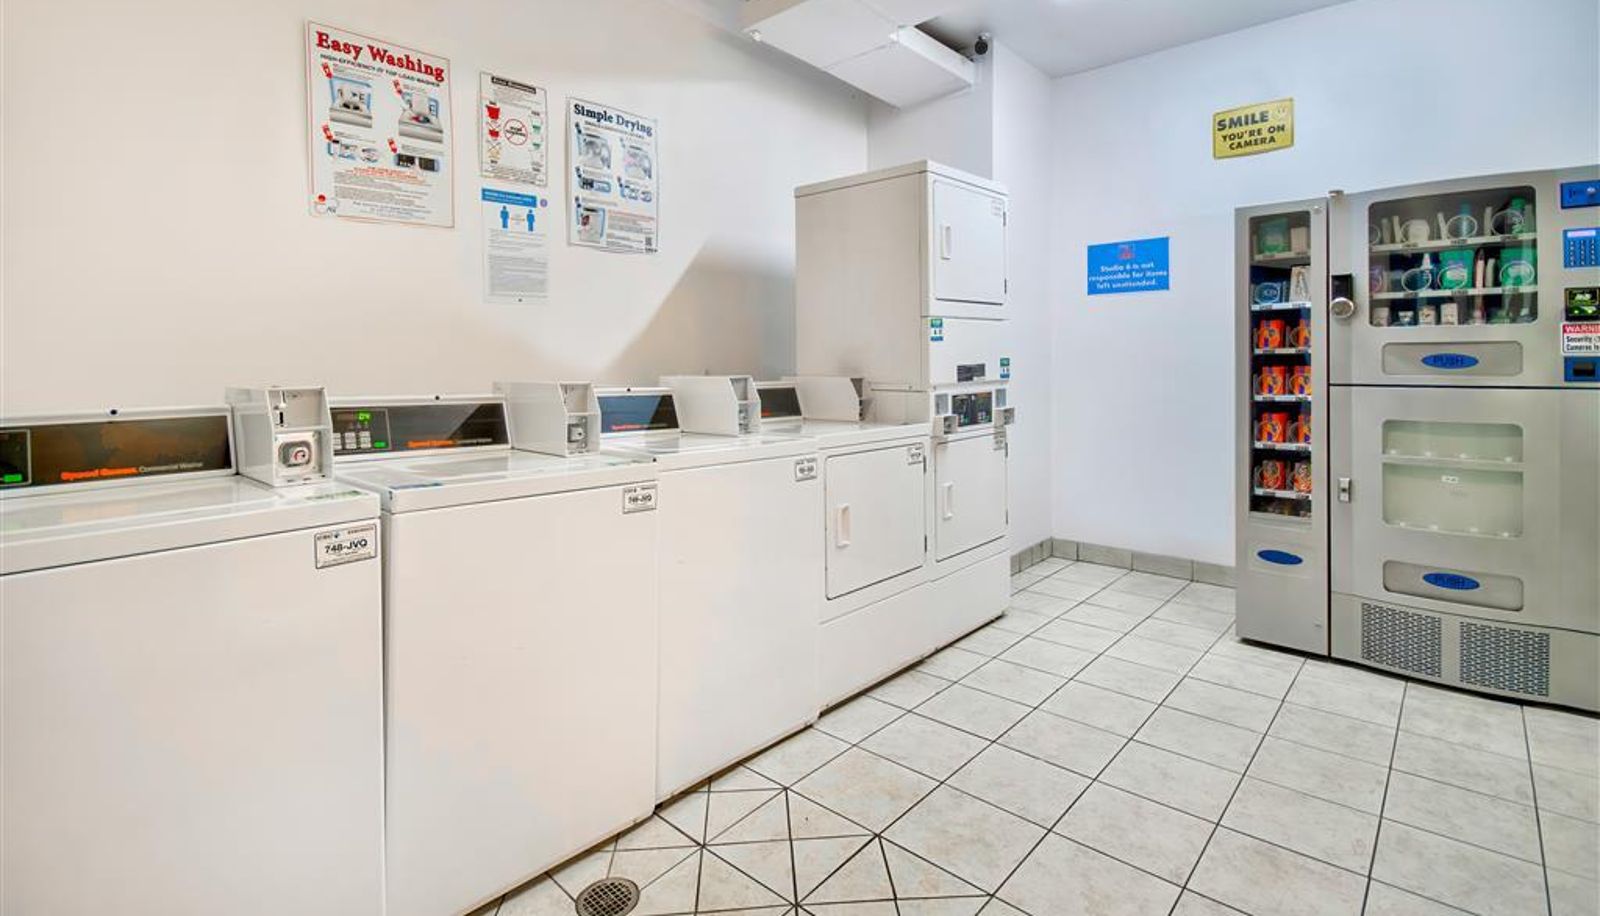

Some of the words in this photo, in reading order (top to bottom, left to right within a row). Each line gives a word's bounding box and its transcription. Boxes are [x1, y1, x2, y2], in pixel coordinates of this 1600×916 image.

[316, 31, 363, 61] Easy
[367, 44, 445, 82] Washing
[574, 103, 614, 128] Simple
[615, 114, 653, 138] Drying
[1217, 111, 1269, 132] SMILE
[1222, 128, 1263, 142] YOU'RE
[1267, 124, 1286, 134] ON
[1229, 135, 1276, 151] CAMERA
[1100, 264, 1125, 273] Studio
[1140, 260, 1155, 269] not
[1088, 272, 1131, 283] responsible
[1132, 271, 1144, 279] for
[1566, 335, 1592, 344] Security
[1566, 343, 1592, 351] Cameras
